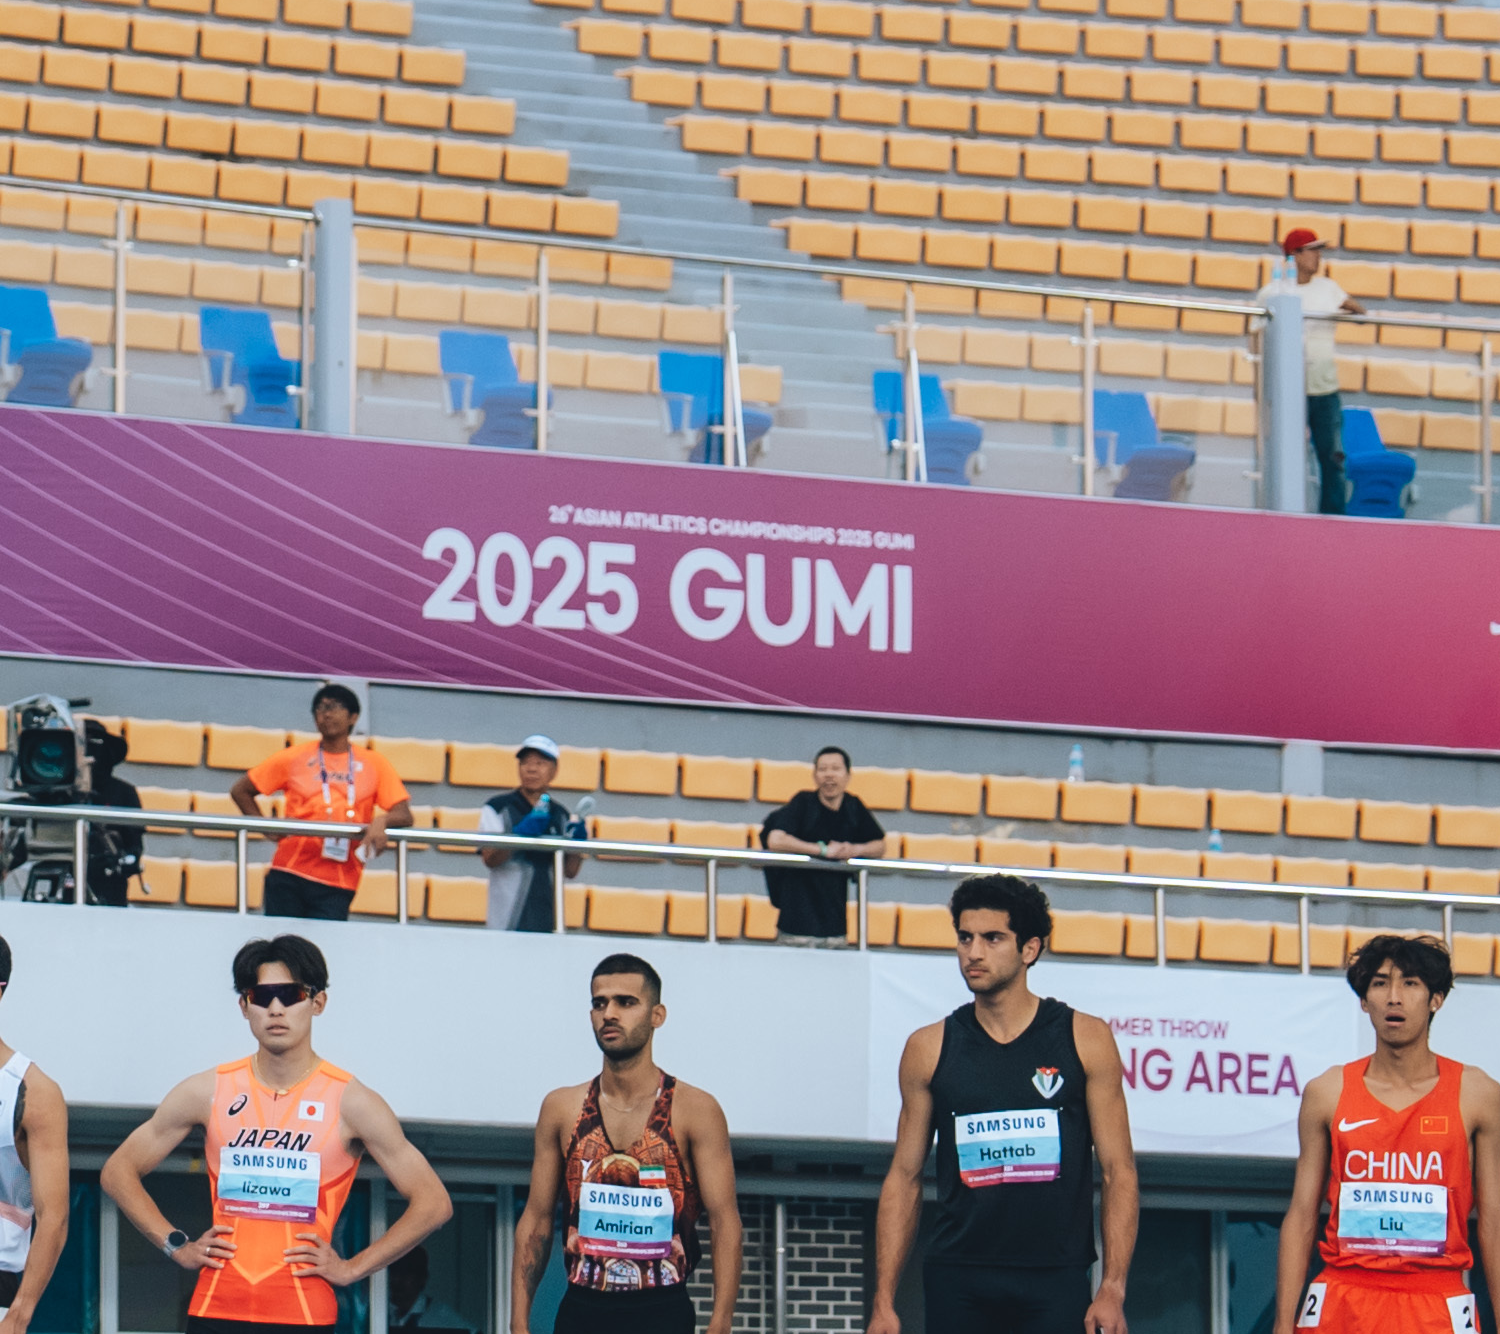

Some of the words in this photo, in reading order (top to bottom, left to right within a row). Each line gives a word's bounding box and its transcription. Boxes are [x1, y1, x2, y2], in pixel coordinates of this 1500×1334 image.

[548, 504, 573, 524] 26
[573, 508, 622, 528] ASIAN
[623, 512, 707, 536] ATHLETICS
[708, 519, 835, 546] CHAMPIONSHIPS
[836, 528, 873, 548] 2025
[874, 531, 915, 551] GUMI
[421, 527, 640, 635] 2025
[669, 547, 914, 654] GUMI
[1159, 1018, 1230, 1039] THROW
[1185, 1050, 1300, 1097] AREA
[967, 1116, 1046, 1135] SAMSUNG
[228, 1128, 311, 1151] JAPAN
[233, 1154, 308, 1171] SAMSUNG
[980, 1144, 1036, 1161] Hattab
[1344, 1150, 1443, 1180] CHINA
[589, 1190, 663, 1208] SAMSUNG
[1353, 1189, 1434, 1204] SAMSUNG
[594, 1218, 653, 1235] Amirian
[1379, 1217, 1403, 1231] Liu
[1306, 1293, 1317, 1316] 2
